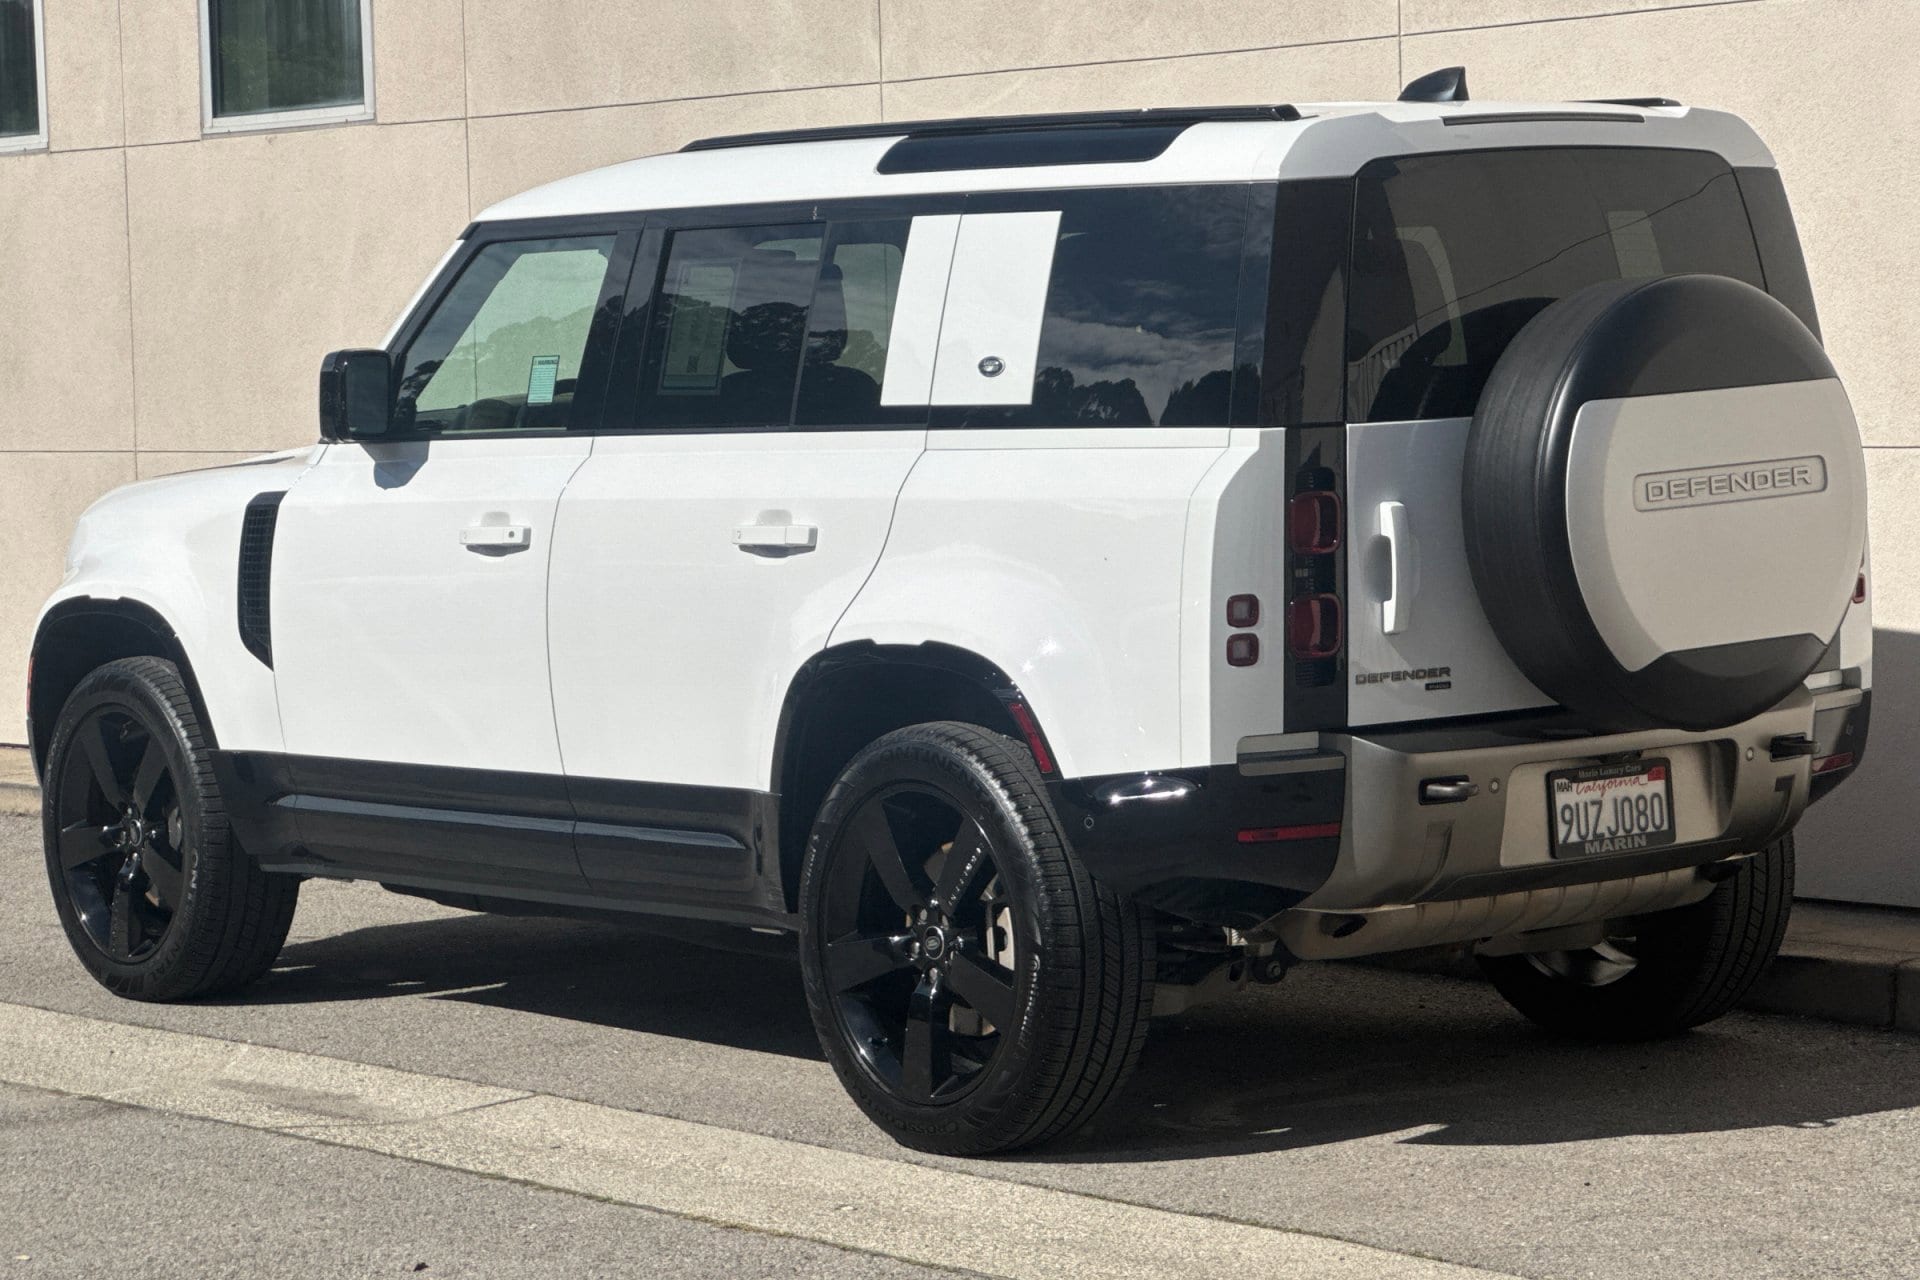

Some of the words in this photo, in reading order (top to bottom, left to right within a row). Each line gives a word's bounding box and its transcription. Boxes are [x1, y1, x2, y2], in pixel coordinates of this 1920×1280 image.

[1646, 465, 1811, 502] DEFENDER
[1355, 666, 1451, 685] DEFENDER
[1599, 766, 1624, 777] Luxury
[1556, 781, 1573, 793] MAR
[1575, 775, 1648, 797] California
[1560, 792, 1665, 844] 9UZJ080
[1584, 834, 1648, 855] MARIN
